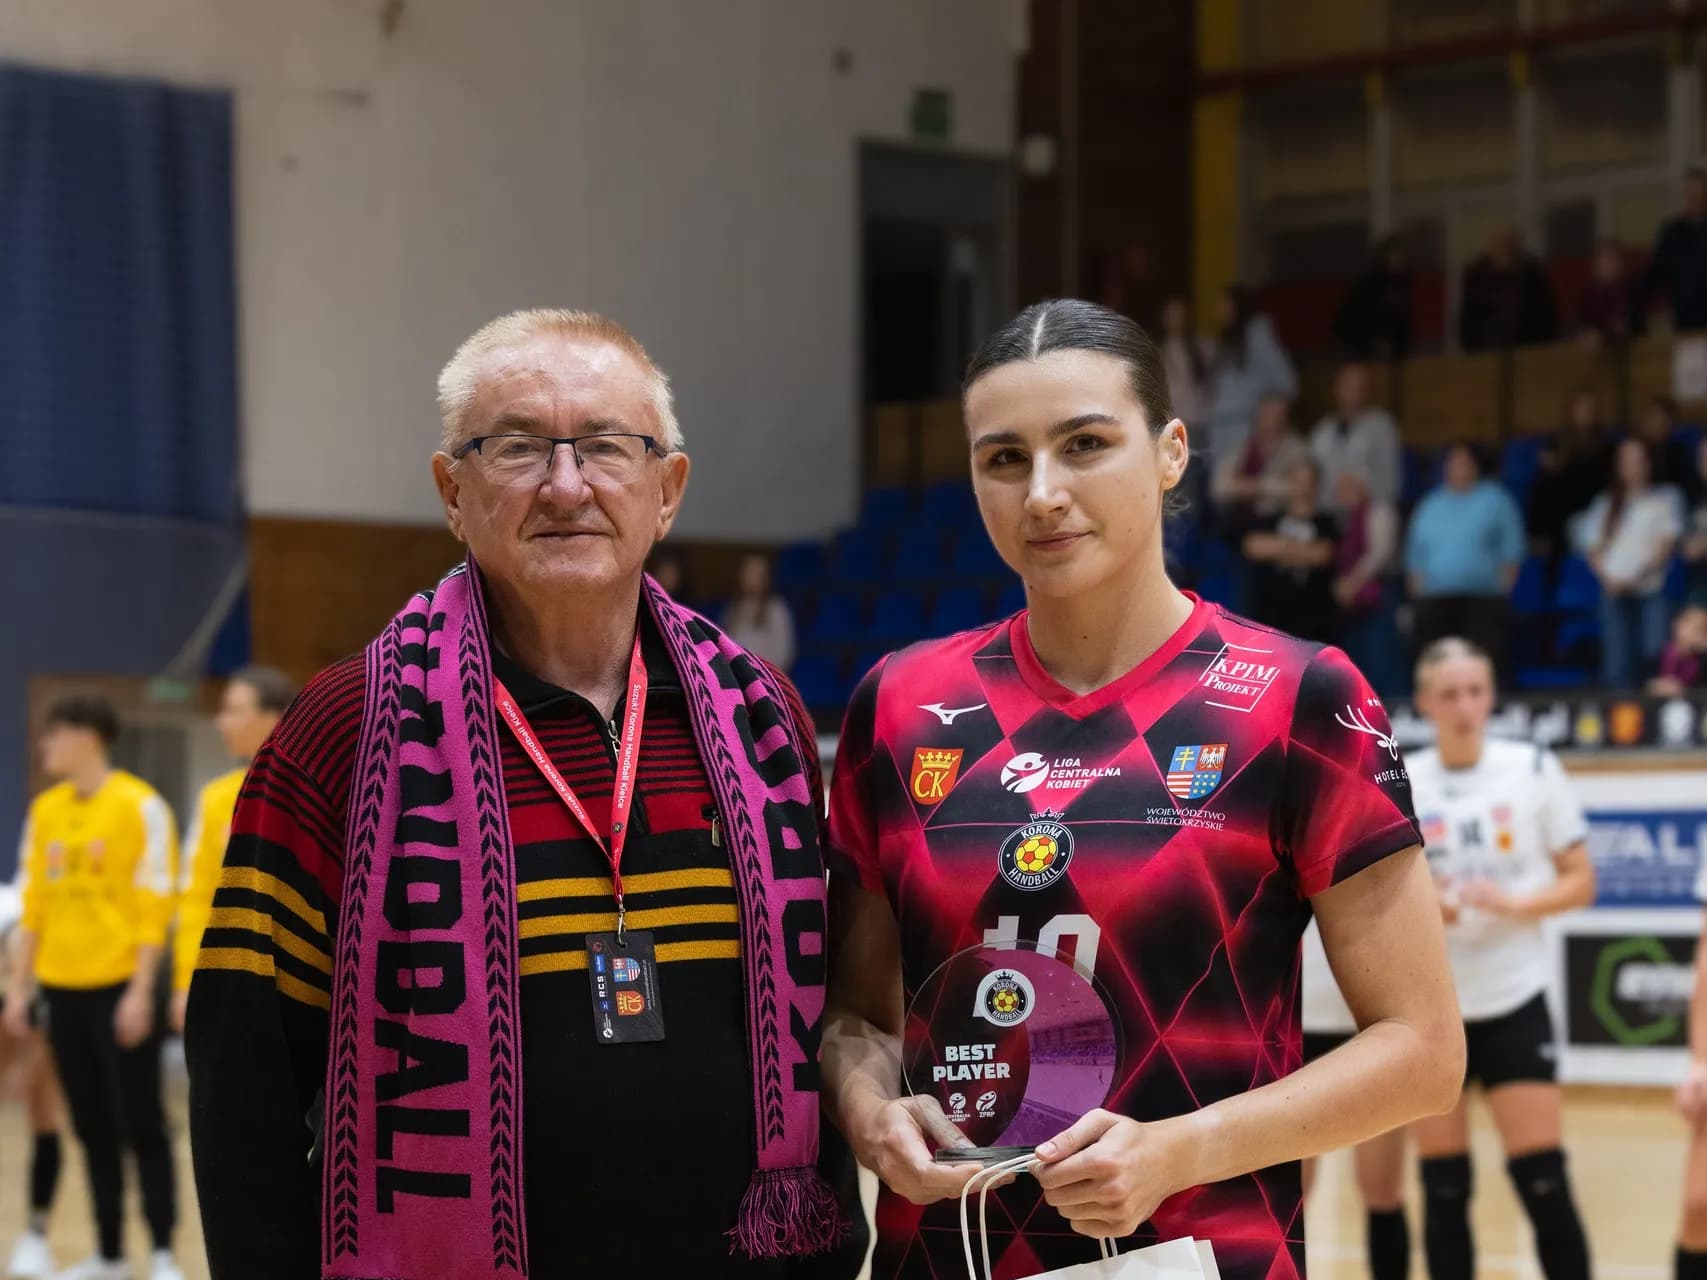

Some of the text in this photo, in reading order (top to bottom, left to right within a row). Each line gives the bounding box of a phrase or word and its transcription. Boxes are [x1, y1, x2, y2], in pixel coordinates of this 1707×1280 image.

[502, 700, 522, 726] Kielce
[517, 726, 545, 763] Handball
[617, 684, 642, 809] Suzuki Korona Handball Kielce
[1053, 758, 1081, 768] LIGA
[1050, 768, 1121, 779] CENTRALNA
[1374, 769, 1400, 784] HOTEL
[914, 770, 950, 798] CK
[1046, 779, 1091, 789] KOBIET
[1020, 825, 1062, 840] KORONA
[1008, 867, 1060, 887] HANDBALL
[597, 975, 606, 998] RCS
[945, 1043, 997, 1062] BEST
[932, 1062, 1011, 1083] PLAYER
